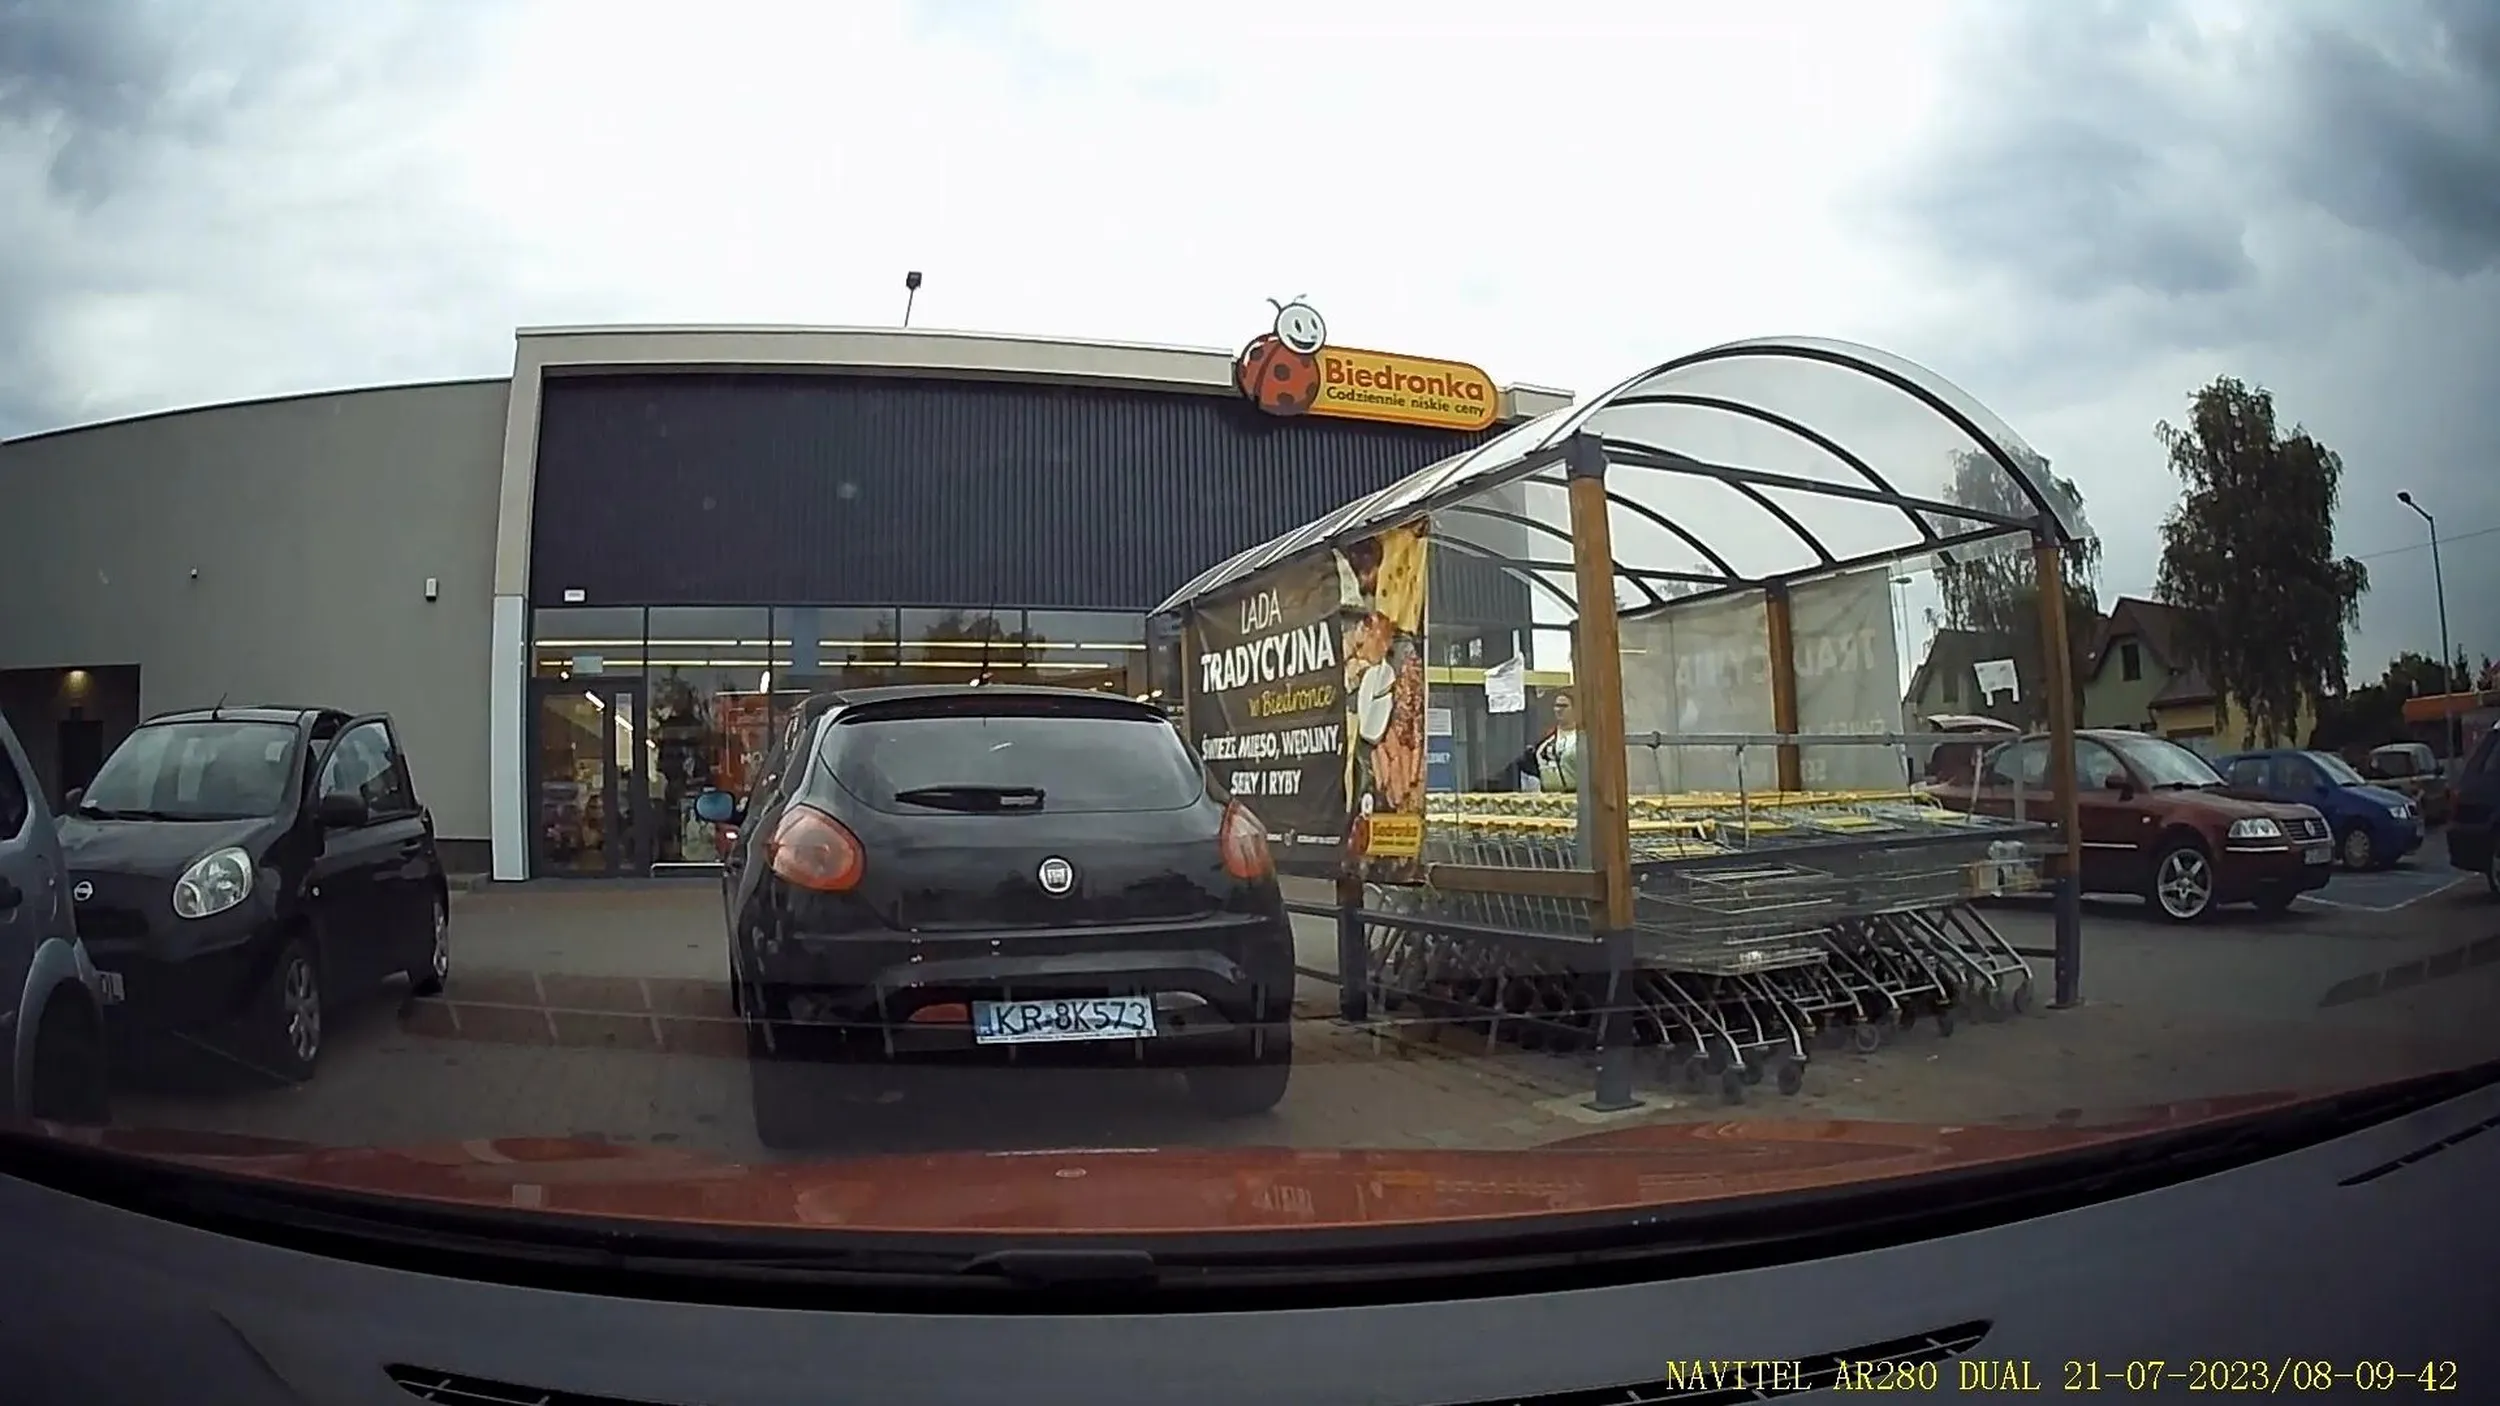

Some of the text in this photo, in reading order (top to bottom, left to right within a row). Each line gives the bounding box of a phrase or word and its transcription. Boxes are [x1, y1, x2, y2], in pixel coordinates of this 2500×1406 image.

[1325, 357, 1485, 402] Biedronka
[1326, 386, 1486, 418] Codziennie niskie ceny
[1240, 587, 1282, 634] LADA
[1200, 621, 1337, 693] TRADYCYJNA
[1262, 682, 1334, 718] Biedronce
[1281, 724, 1343, 761] WĘDLINY,
[1230, 771, 1259, 795] SERY
[1269, 769, 1302, 795] RYBY
[995, 1004, 1043, 1035] KR
[1055, 1000, 1148, 1031] 8K573
